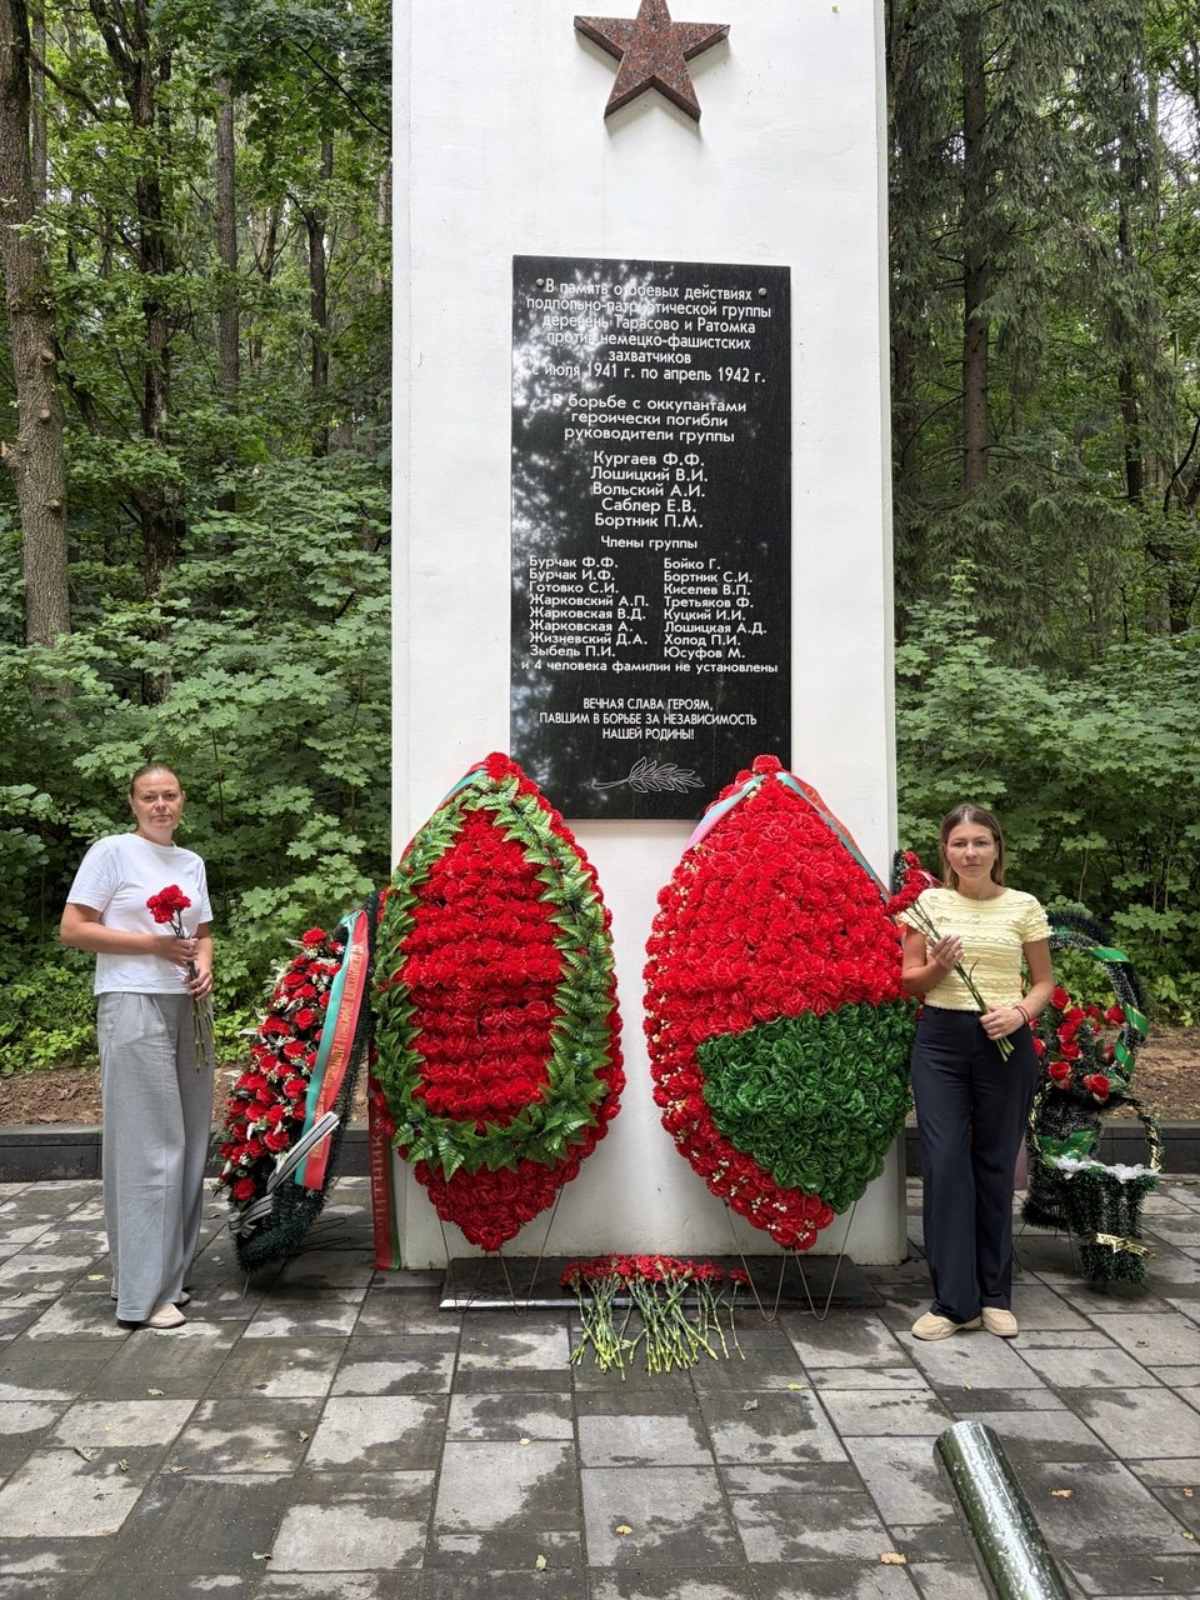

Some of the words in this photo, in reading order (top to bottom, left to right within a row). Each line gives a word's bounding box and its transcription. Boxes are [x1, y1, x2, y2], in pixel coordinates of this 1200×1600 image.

[545, 279, 555, 293] В
[559, 282, 608, 296] память
[684, 286, 752, 301] действиях
[722, 304, 771, 319] группы
[614, 314, 679, 332] Тарасово
[684, 321, 693, 331] и
[697, 318, 756, 333] Ратомка
[600, 332, 751, 351] немецко-фашистских
[608, 351, 691, 364] захватчиков
[544, 365, 581, 379] июля
[587, 363, 617, 378] 1941
[624, 368, 635, 379] г.
[641, 368, 658, 380] по
[663, 369, 712, 384] апрель
[718, 368, 749, 383] 1942
[755, 373, 766, 383] г.
[568, 395, 626, 410] борьбе
[633, 399, 640, 409] с
[647, 399, 746, 413] оккупантами
[571, 412, 661, 428] героически
[666, 414, 728, 427] погибли
[564, 427, 674, 441] руководители
[679, 431, 735, 444] группы
[593, 451, 657, 467] Кургаев
[663, 453, 705, 467] Ф.Ф.
[590, 465, 670, 482] Лошицкий
[676, 469, 708, 482] В.И.
[593, 482, 664, 496] Вольский
[670, 485, 706, 497] А.И.
[601, 498, 661, 513] Саблер
[667, 500, 696, 512] Е.В.
[594, 513, 658, 529] Бортник
[664, 515, 703, 528] П.М.
[601, 536, 644, 549] Члены
[649, 539, 697, 551] группы
[529, 556, 576, 570] Бурчак
[582, 557, 618, 568] Ф.Ф.
[664, 558, 704, 570] Бойко
[709, 558, 720, 570] Г.
[529, 569, 576, 582] Бурчак
[582, 570, 615, 581] И.Ф.
[664, 571, 718, 584] Бортник
[723, 572, 752, 583] С.И.
[529, 581, 583, 594] Готовко
[588, 583, 619, 594] С.И.
[664, 584, 718, 595] Киселев
[723, 585, 751, 595] В.П.
[529, 594, 613, 607] Жарковский
[618, 595, 649, 607] А.П.
[664, 596, 731, 610] Третьяков
[736, 597, 754, 608] Ф.
[529, 607, 612, 620] Жарковская
[617, 608, 646, 621] В.Д.
[664, 609, 711, 622] Куцкий
[716, 610, 746, 621] И.И.
[529, 619, 612, 633] Жарковская
[618, 621, 633, 632] А.
[664, 622, 731, 635] Лошицкая
[736, 623, 767, 635] А.Д.
[529, 632, 612, 645] Жизневский
[616, 633, 647, 647] Д.А.
[664, 636, 706, 648] Холод
[710, 635, 740, 646] П.И.
[529, 645, 581, 657] Зыбель
[586, 646, 615, 657] П.И.
[664, 647, 723, 660] Юсуфов
[728, 648, 745, 659] М.
[522, 662, 529, 670] и
[534, 661, 541, 670] 4
[547, 662, 607, 672] человека
[612, 662, 670, 674] фамилии
[675, 663, 690, 672] не
[696, 664, 778, 674] установлены
[583, 698, 624, 710] ВЕЧНАЯ
[627, 698, 664, 710] СЛАВА
[667, 698, 713, 711] ГЕРОЯМ,
[540, 712, 591, 724] ПАВШИМ
[593, 713, 600, 724] В
[603, 713, 641, 724] БОРЬБЕ
[646, 714, 659, 724] ЗА
[664, 714, 757, 726] НЕЗАВИСИМОСТЬ
[603, 728, 642, 739] НАШЕЙ
[646, 729, 694, 741] РОДИНЫ!
